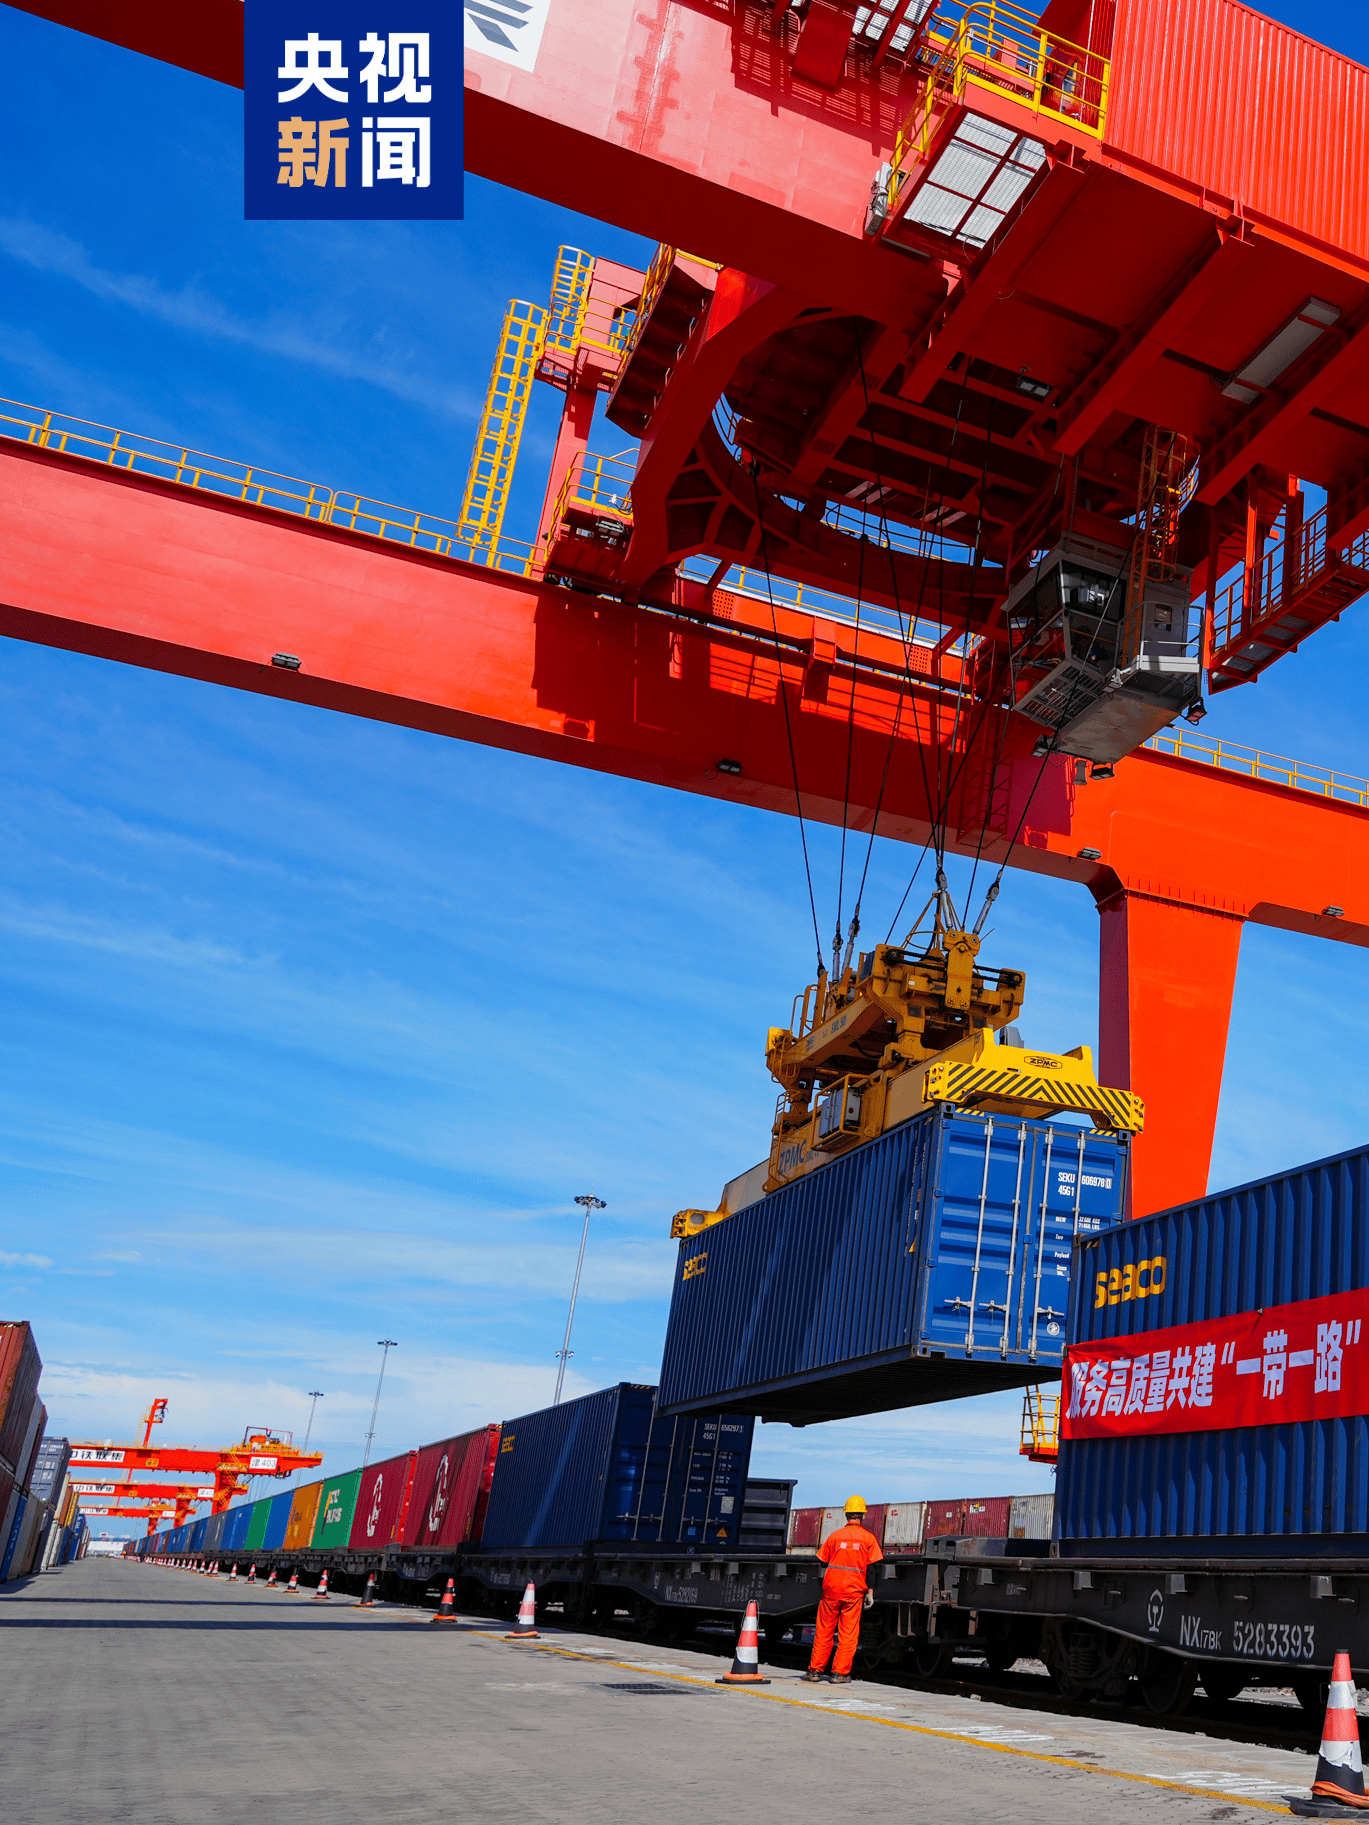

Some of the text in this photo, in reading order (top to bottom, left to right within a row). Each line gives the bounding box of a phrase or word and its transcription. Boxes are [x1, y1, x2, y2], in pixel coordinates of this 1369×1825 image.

[1030, 1057, 1058, 1068] ZPMC
[1058, 1171, 1076, 1184] SEKU
[1058, 1184, 1075, 1197] 45G1
[1094, 1255, 1168, 1310] seaco
[702, 1432, 716, 1440] 45G1
[1232, 1620, 1315, 1660] 5283393
